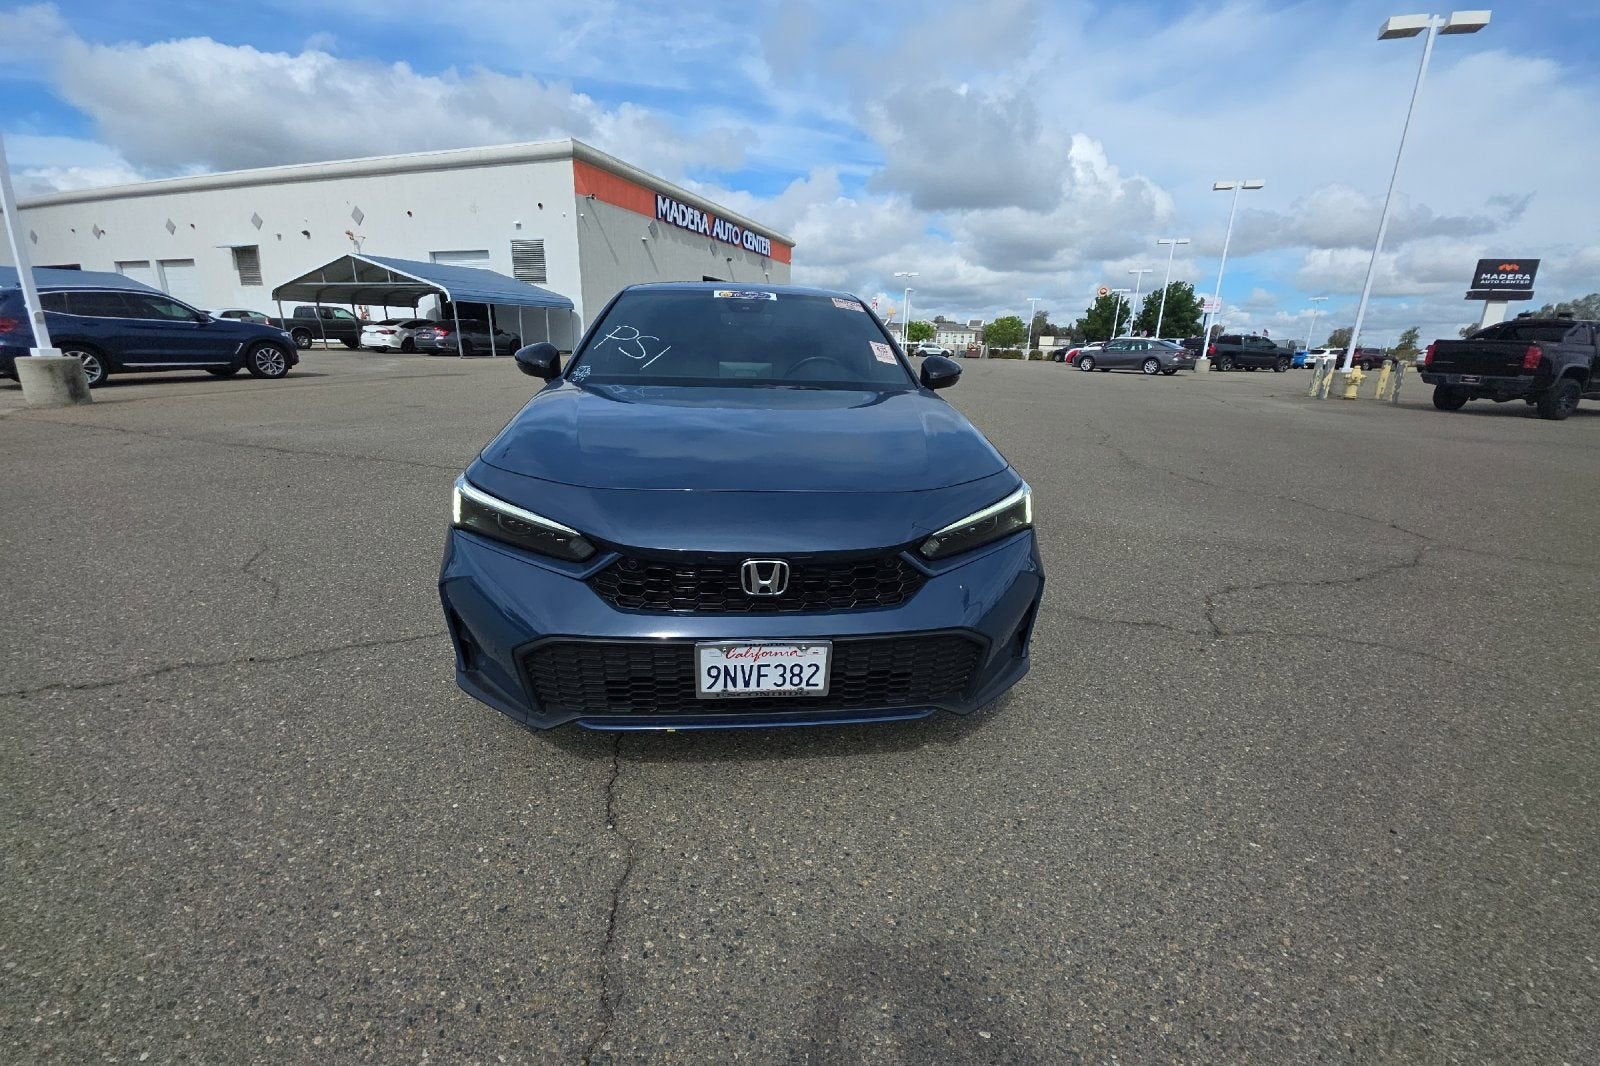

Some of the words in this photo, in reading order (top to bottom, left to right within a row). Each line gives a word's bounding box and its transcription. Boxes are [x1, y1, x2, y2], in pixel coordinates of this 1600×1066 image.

[657, 195, 709, 235] MADERA
[712, 218, 740, 245] AUTO
[742, 230, 771, 257] CENTER
[725, 646, 800, 662] California
[706, 663, 820, 690] 9NVF382
